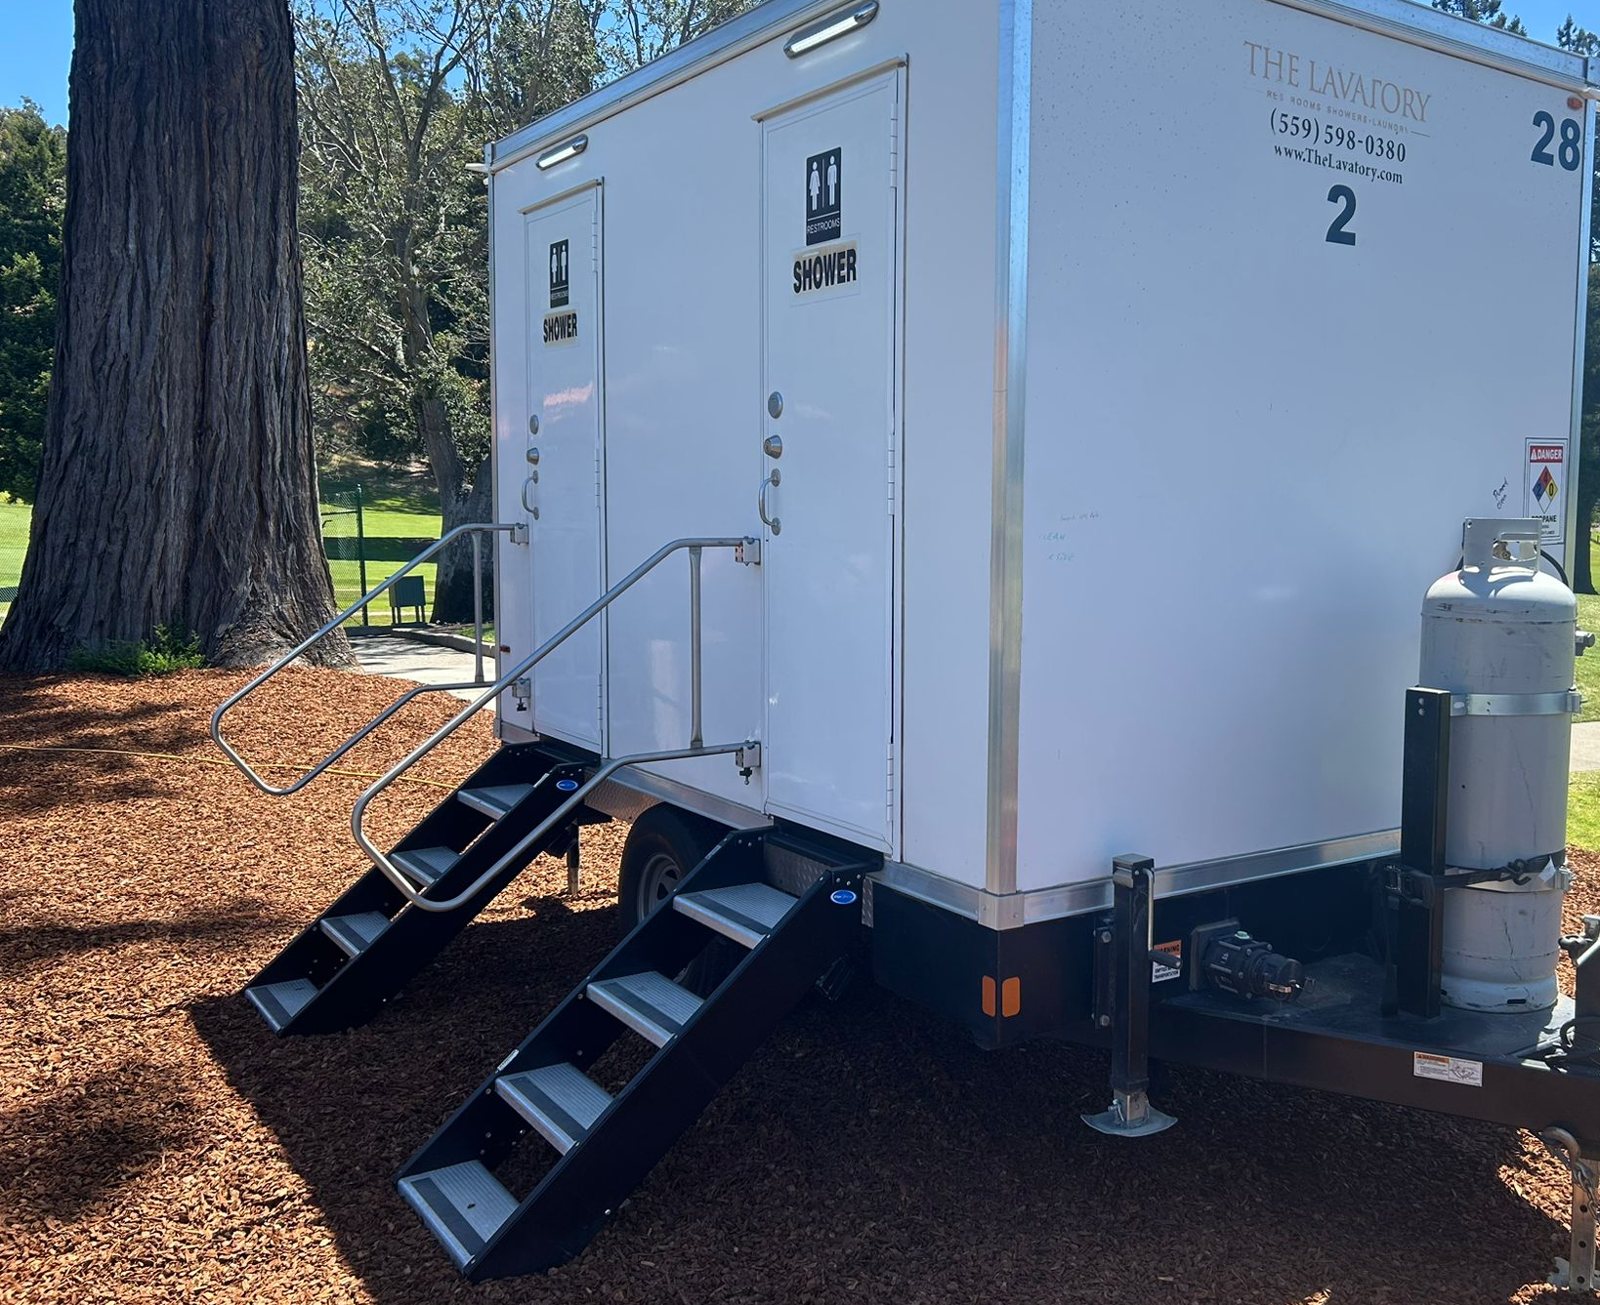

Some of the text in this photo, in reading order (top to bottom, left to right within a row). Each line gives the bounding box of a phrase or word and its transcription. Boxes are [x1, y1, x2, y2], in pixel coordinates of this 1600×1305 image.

[1243, 41, 1430, 122] THE LAVATORY
[1270, 107, 1406, 162] (559) 598-0380
[1530, 110, 1580, 171] 28
[1273, 145, 1402, 184] www.TheLavatory.com
[806, 217, 840, 234] RESTROOMS
[1326, 184, 1355, 246] 2
[793, 248, 857, 294] SHOWER
[543, 313, 577, 343] SHOWER
[1537, 448, 1563, 460] DANGER
[1548, 482, 1555, 497] 0
